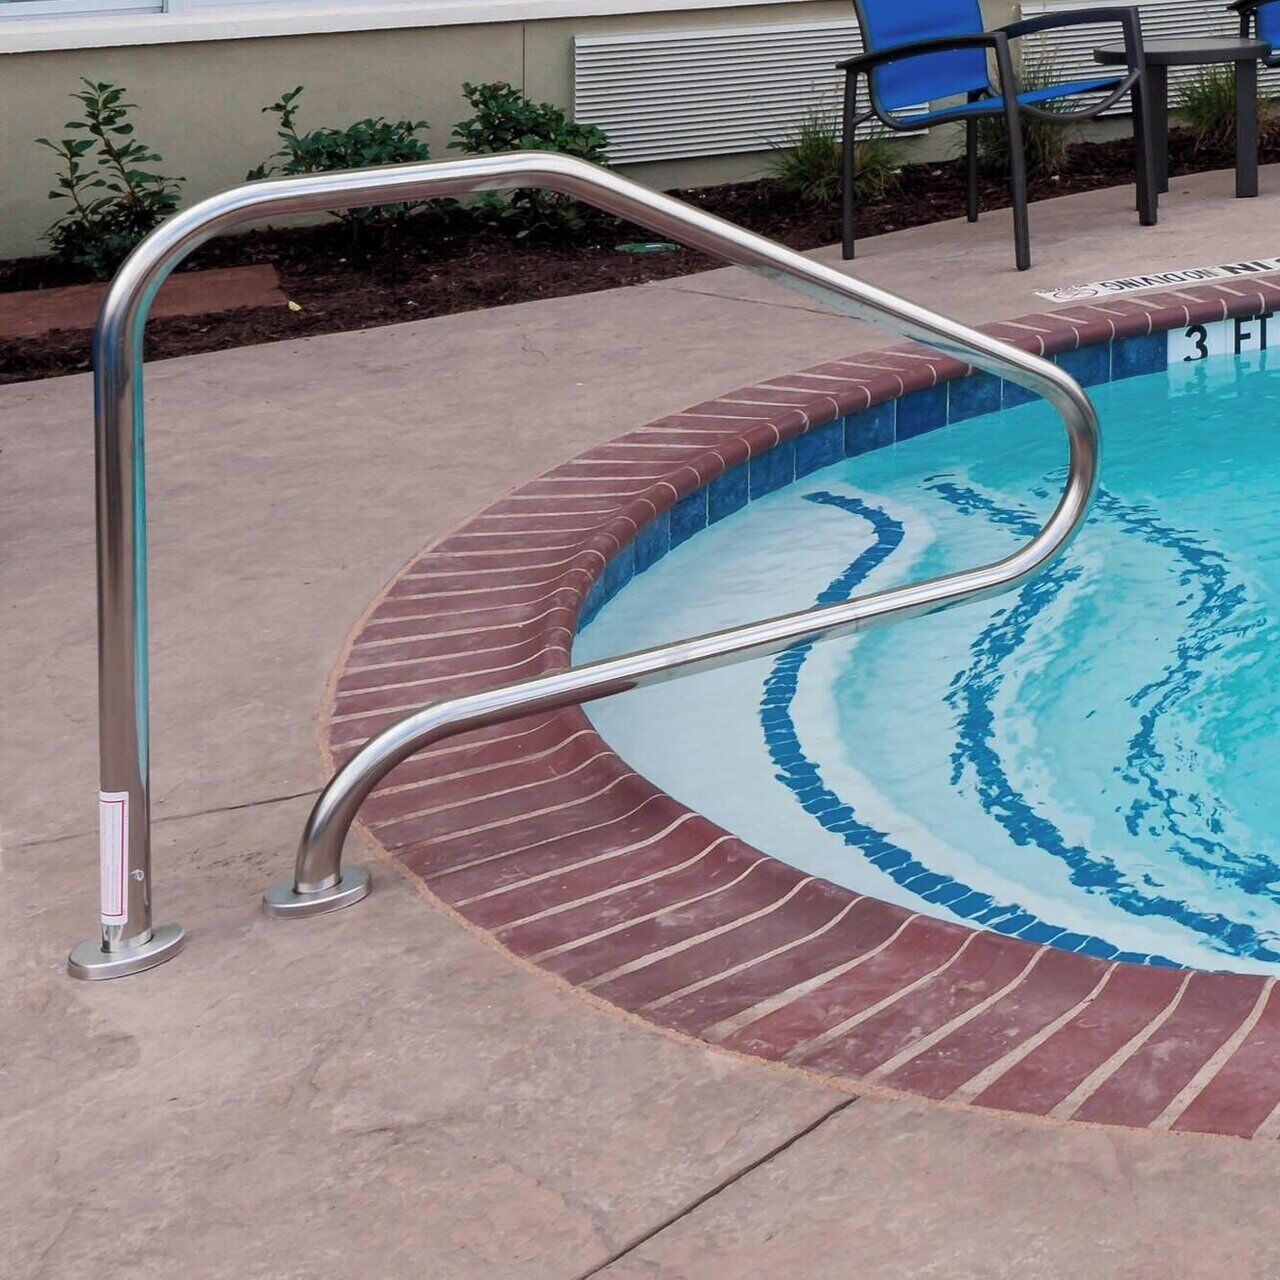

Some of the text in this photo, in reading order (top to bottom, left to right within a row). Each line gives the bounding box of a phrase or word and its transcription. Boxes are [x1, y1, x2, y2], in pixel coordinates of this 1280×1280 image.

[1100, 273, 1183, 291] DIVING
[1183, 324, 1209, 362] 3
[1233, 312, 1273, 355] FT
